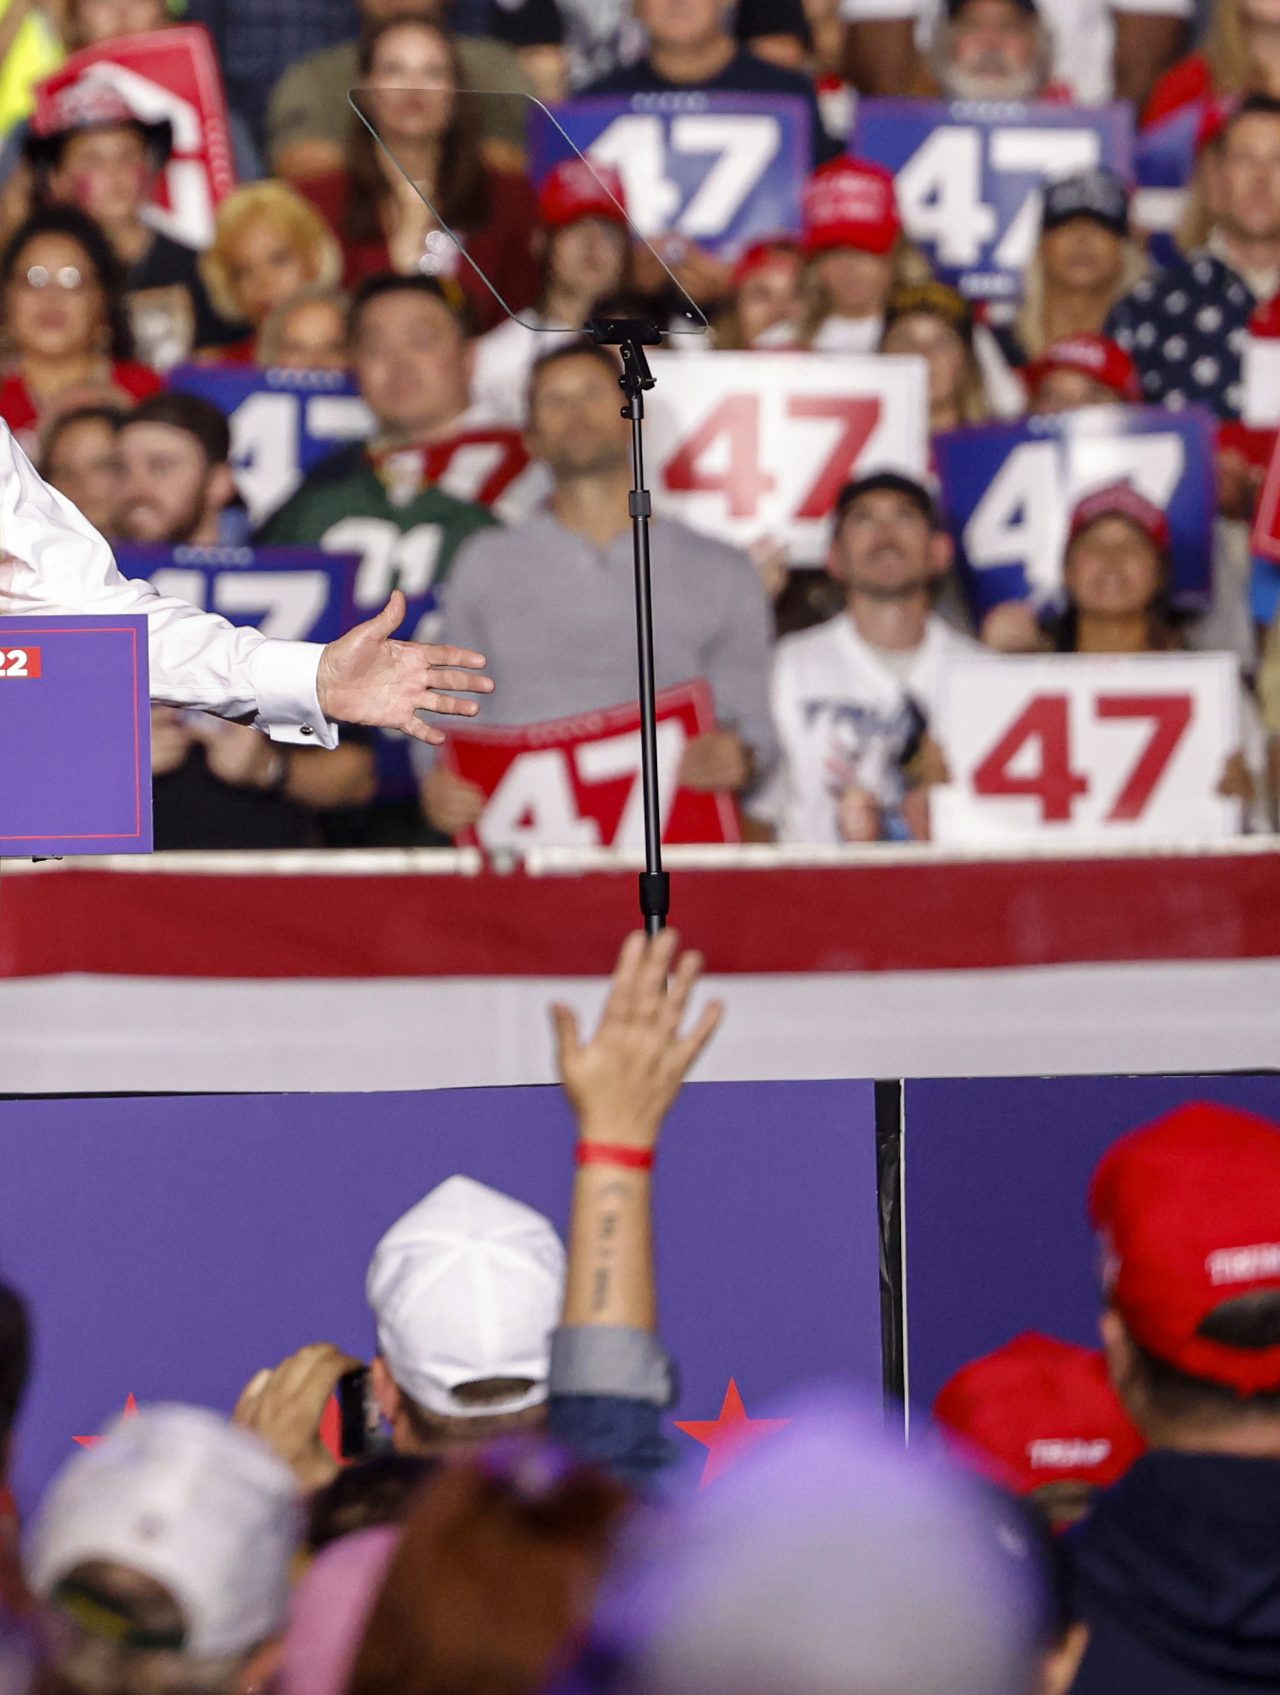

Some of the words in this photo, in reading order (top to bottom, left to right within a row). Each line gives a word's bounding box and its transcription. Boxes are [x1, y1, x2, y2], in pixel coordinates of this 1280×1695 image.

[661, 393, 882, 520] 47
[476, 717, 688, 848] 47
[972, 691, 1196, 824] 47
